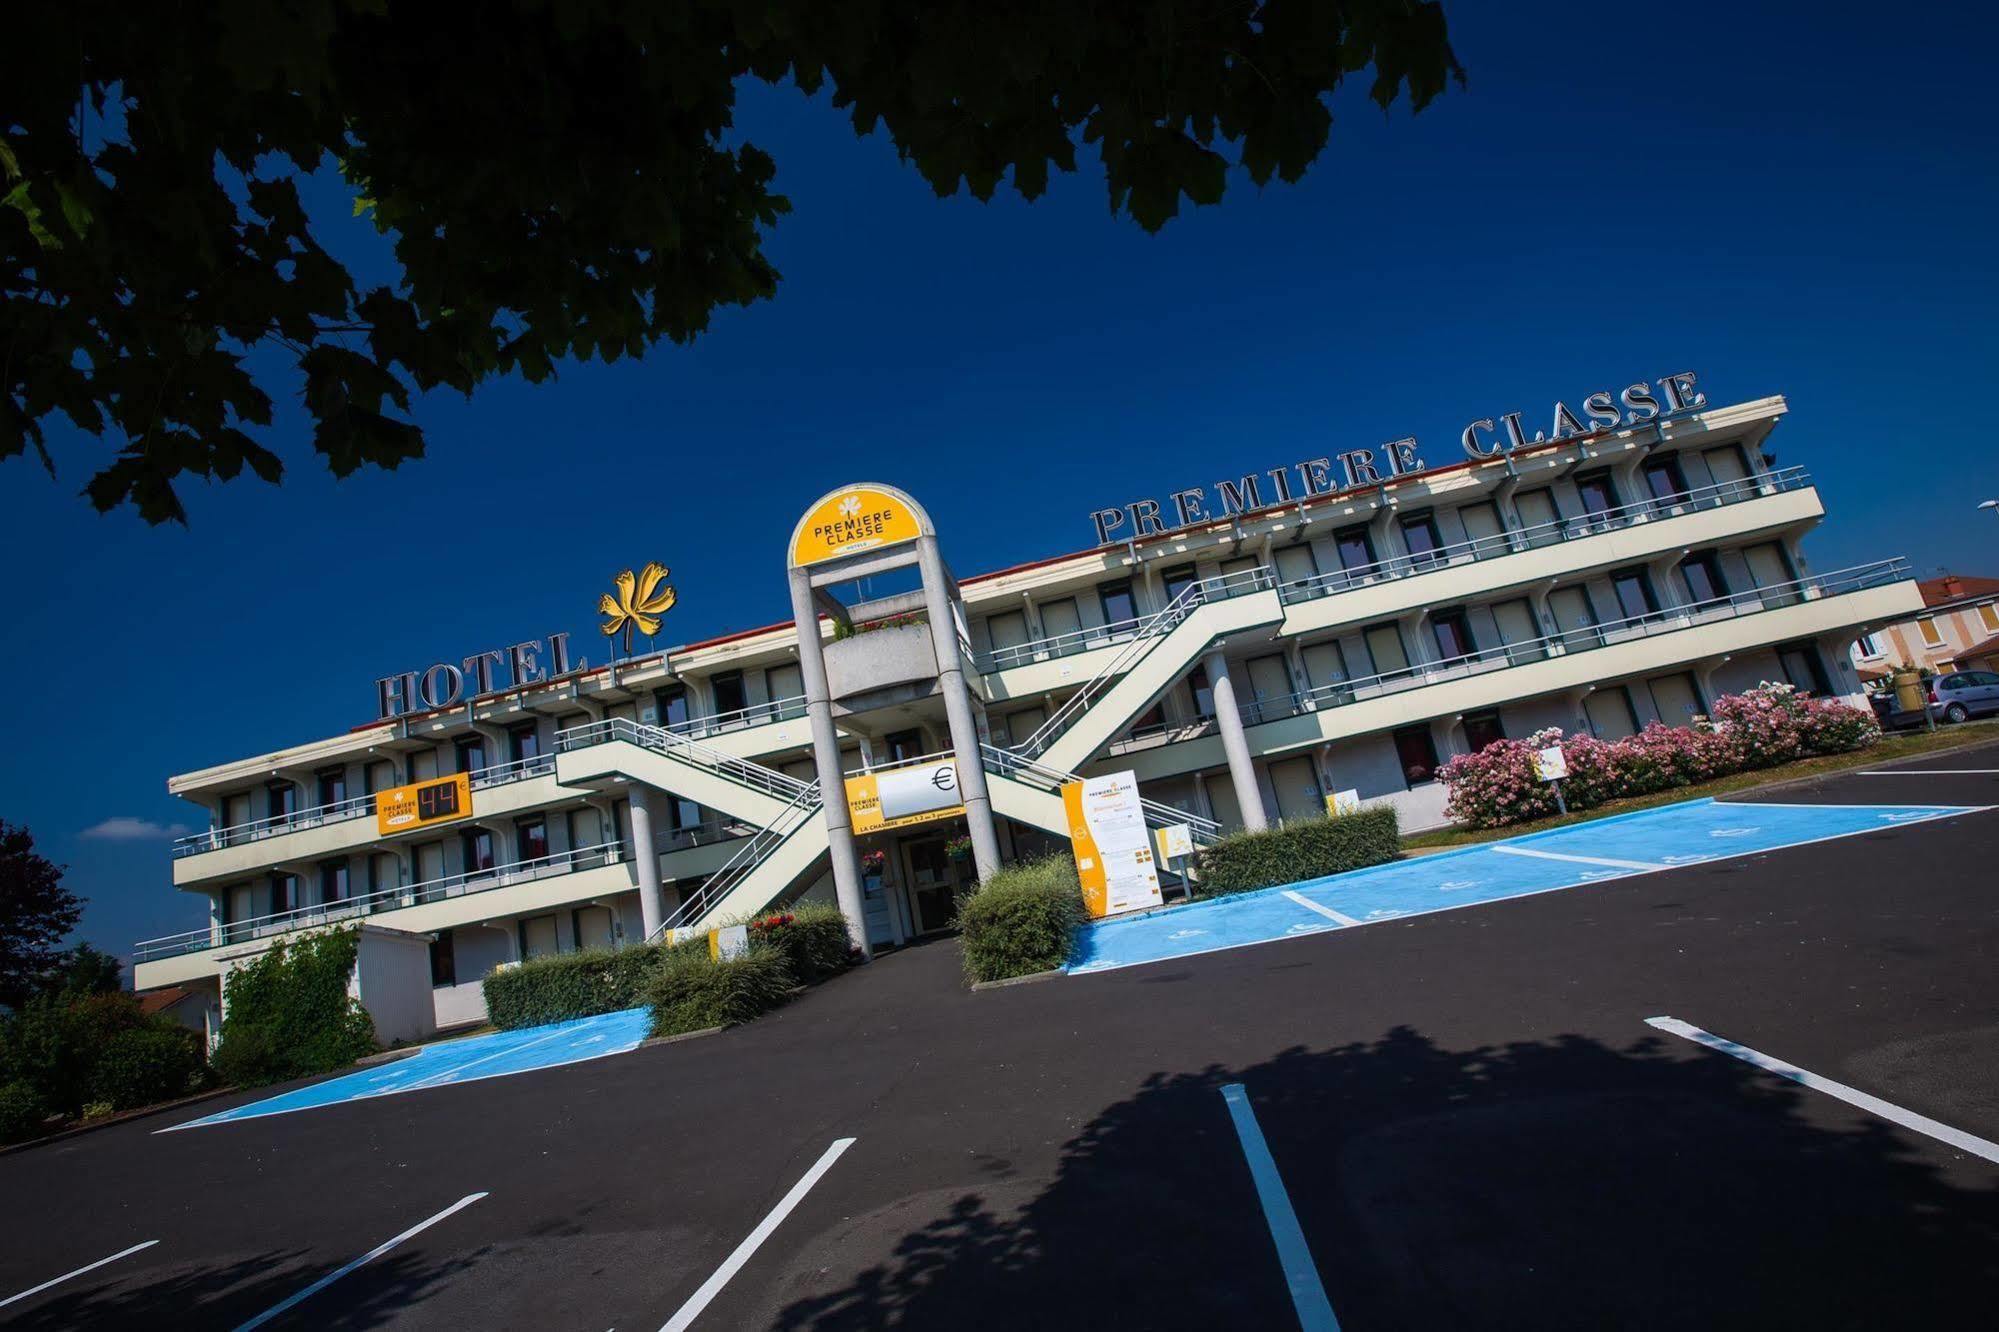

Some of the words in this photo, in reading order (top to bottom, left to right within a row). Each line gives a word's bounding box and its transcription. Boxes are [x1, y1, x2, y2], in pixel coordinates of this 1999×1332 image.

[1090, 436, 1425, 545] PREMIERE
[1461, 371, 1706, 460] CLASSE
[814, 509, 893, 538] PREMIERE
[826, 523, 884, 546] CLASSE
[376, 631, 589, 718] HOTEL
[932, 767, 956, 791] €
[421, 782, 454, 815] 44
[1089, 788, 1113, 797] PREMIERE
[384, 801, 416, 812] PREMIERE
[850, 797, 879, 806] PREMIERE
[854, 802, 876, 811] CLASSE
[388, 807, 412, 818] CLASSE
[869, 820, 898, 831] CHAMBRE
